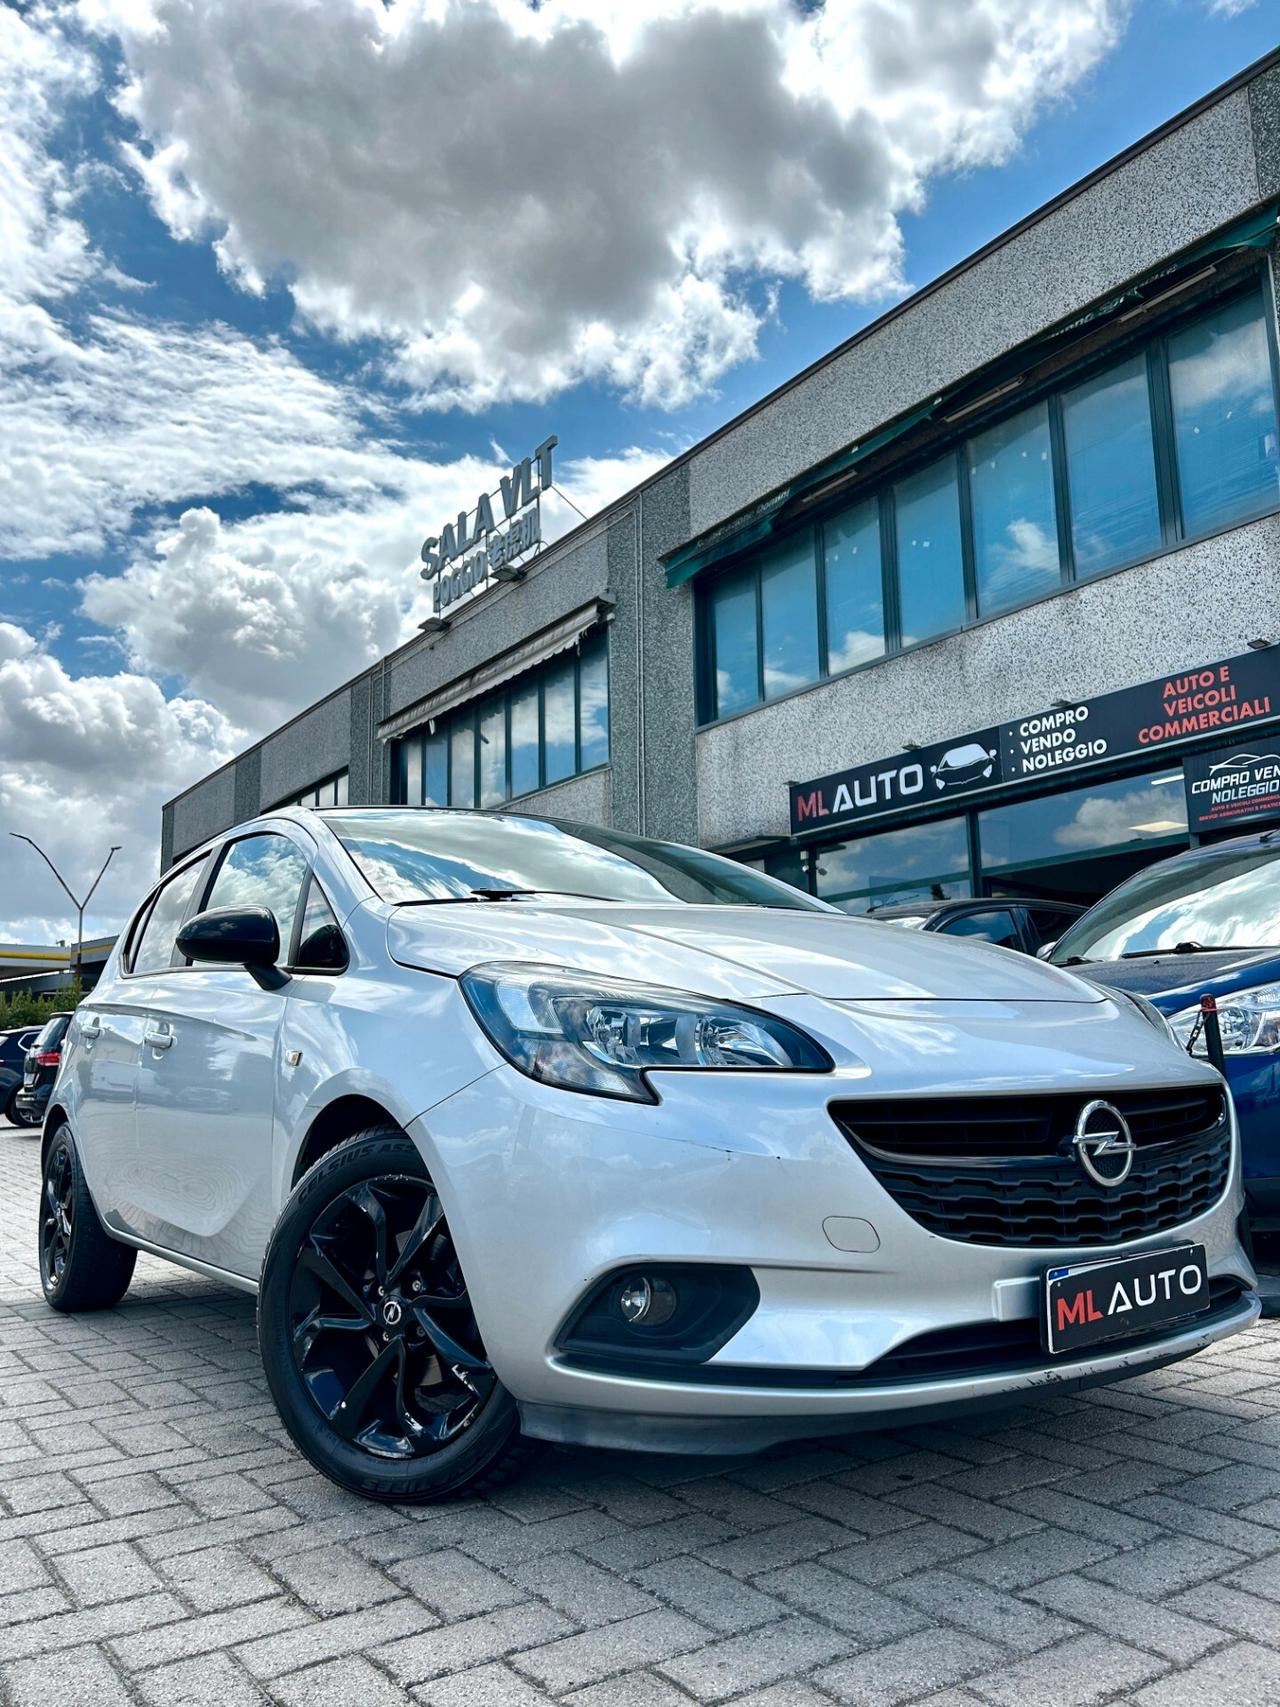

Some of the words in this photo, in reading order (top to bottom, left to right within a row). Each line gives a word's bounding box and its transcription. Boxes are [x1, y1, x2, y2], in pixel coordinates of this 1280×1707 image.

[420, 492, 495, 580] SALA
[500, 434, 558, 518] VLT
[1163, 671, 1215, 699] AUTO
[1220, 666, 1230, 681] E
[1163, 685, 1236, 717] VEICOLI
[1019, 705, 1089, 737] COMPRO
[1138, 697, 1271, 744] COMMERCIALI
[1020, 728, 1076, 755] VENDO
[1022, 739, 1107, 773] NOLEGGIO
[1191, 771, 1250, 794] COMPRO
[1211, 780, 1280, 804] NOLEGGIO
